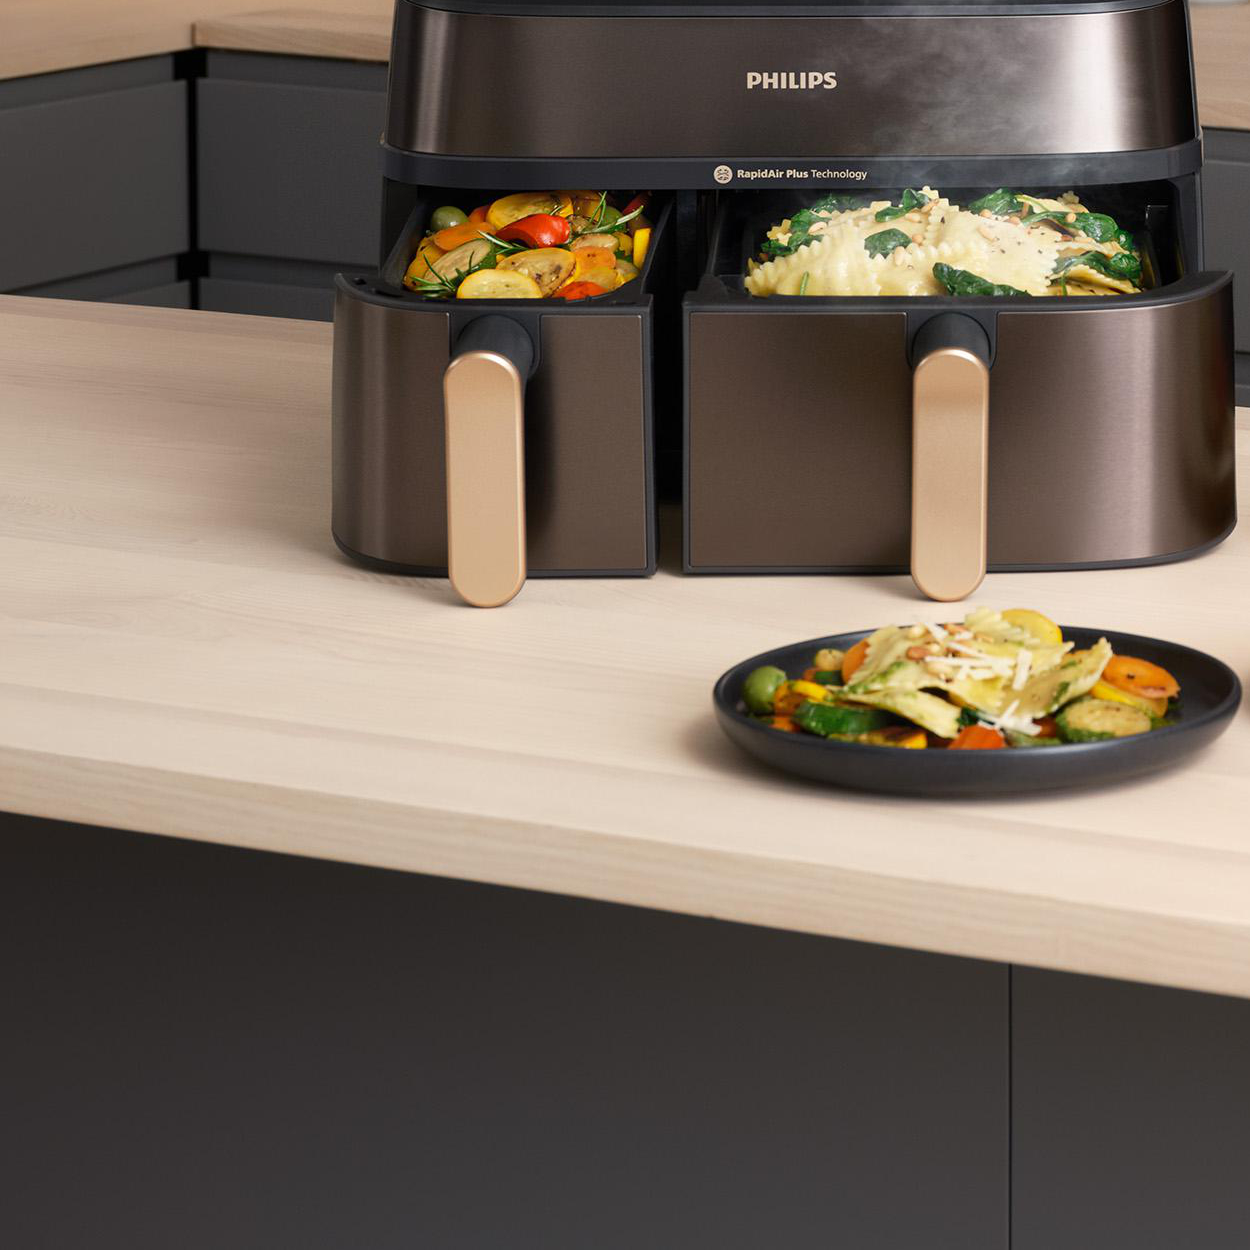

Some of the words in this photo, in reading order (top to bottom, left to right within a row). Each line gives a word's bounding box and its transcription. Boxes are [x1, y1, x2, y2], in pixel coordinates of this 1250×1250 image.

[746, 71, 838, 89] PHILIPS
[737, 169, 784, 180] RapidAir
[786, 169, 809, 179] Plus
[811, 169, 868, 181] Technology
